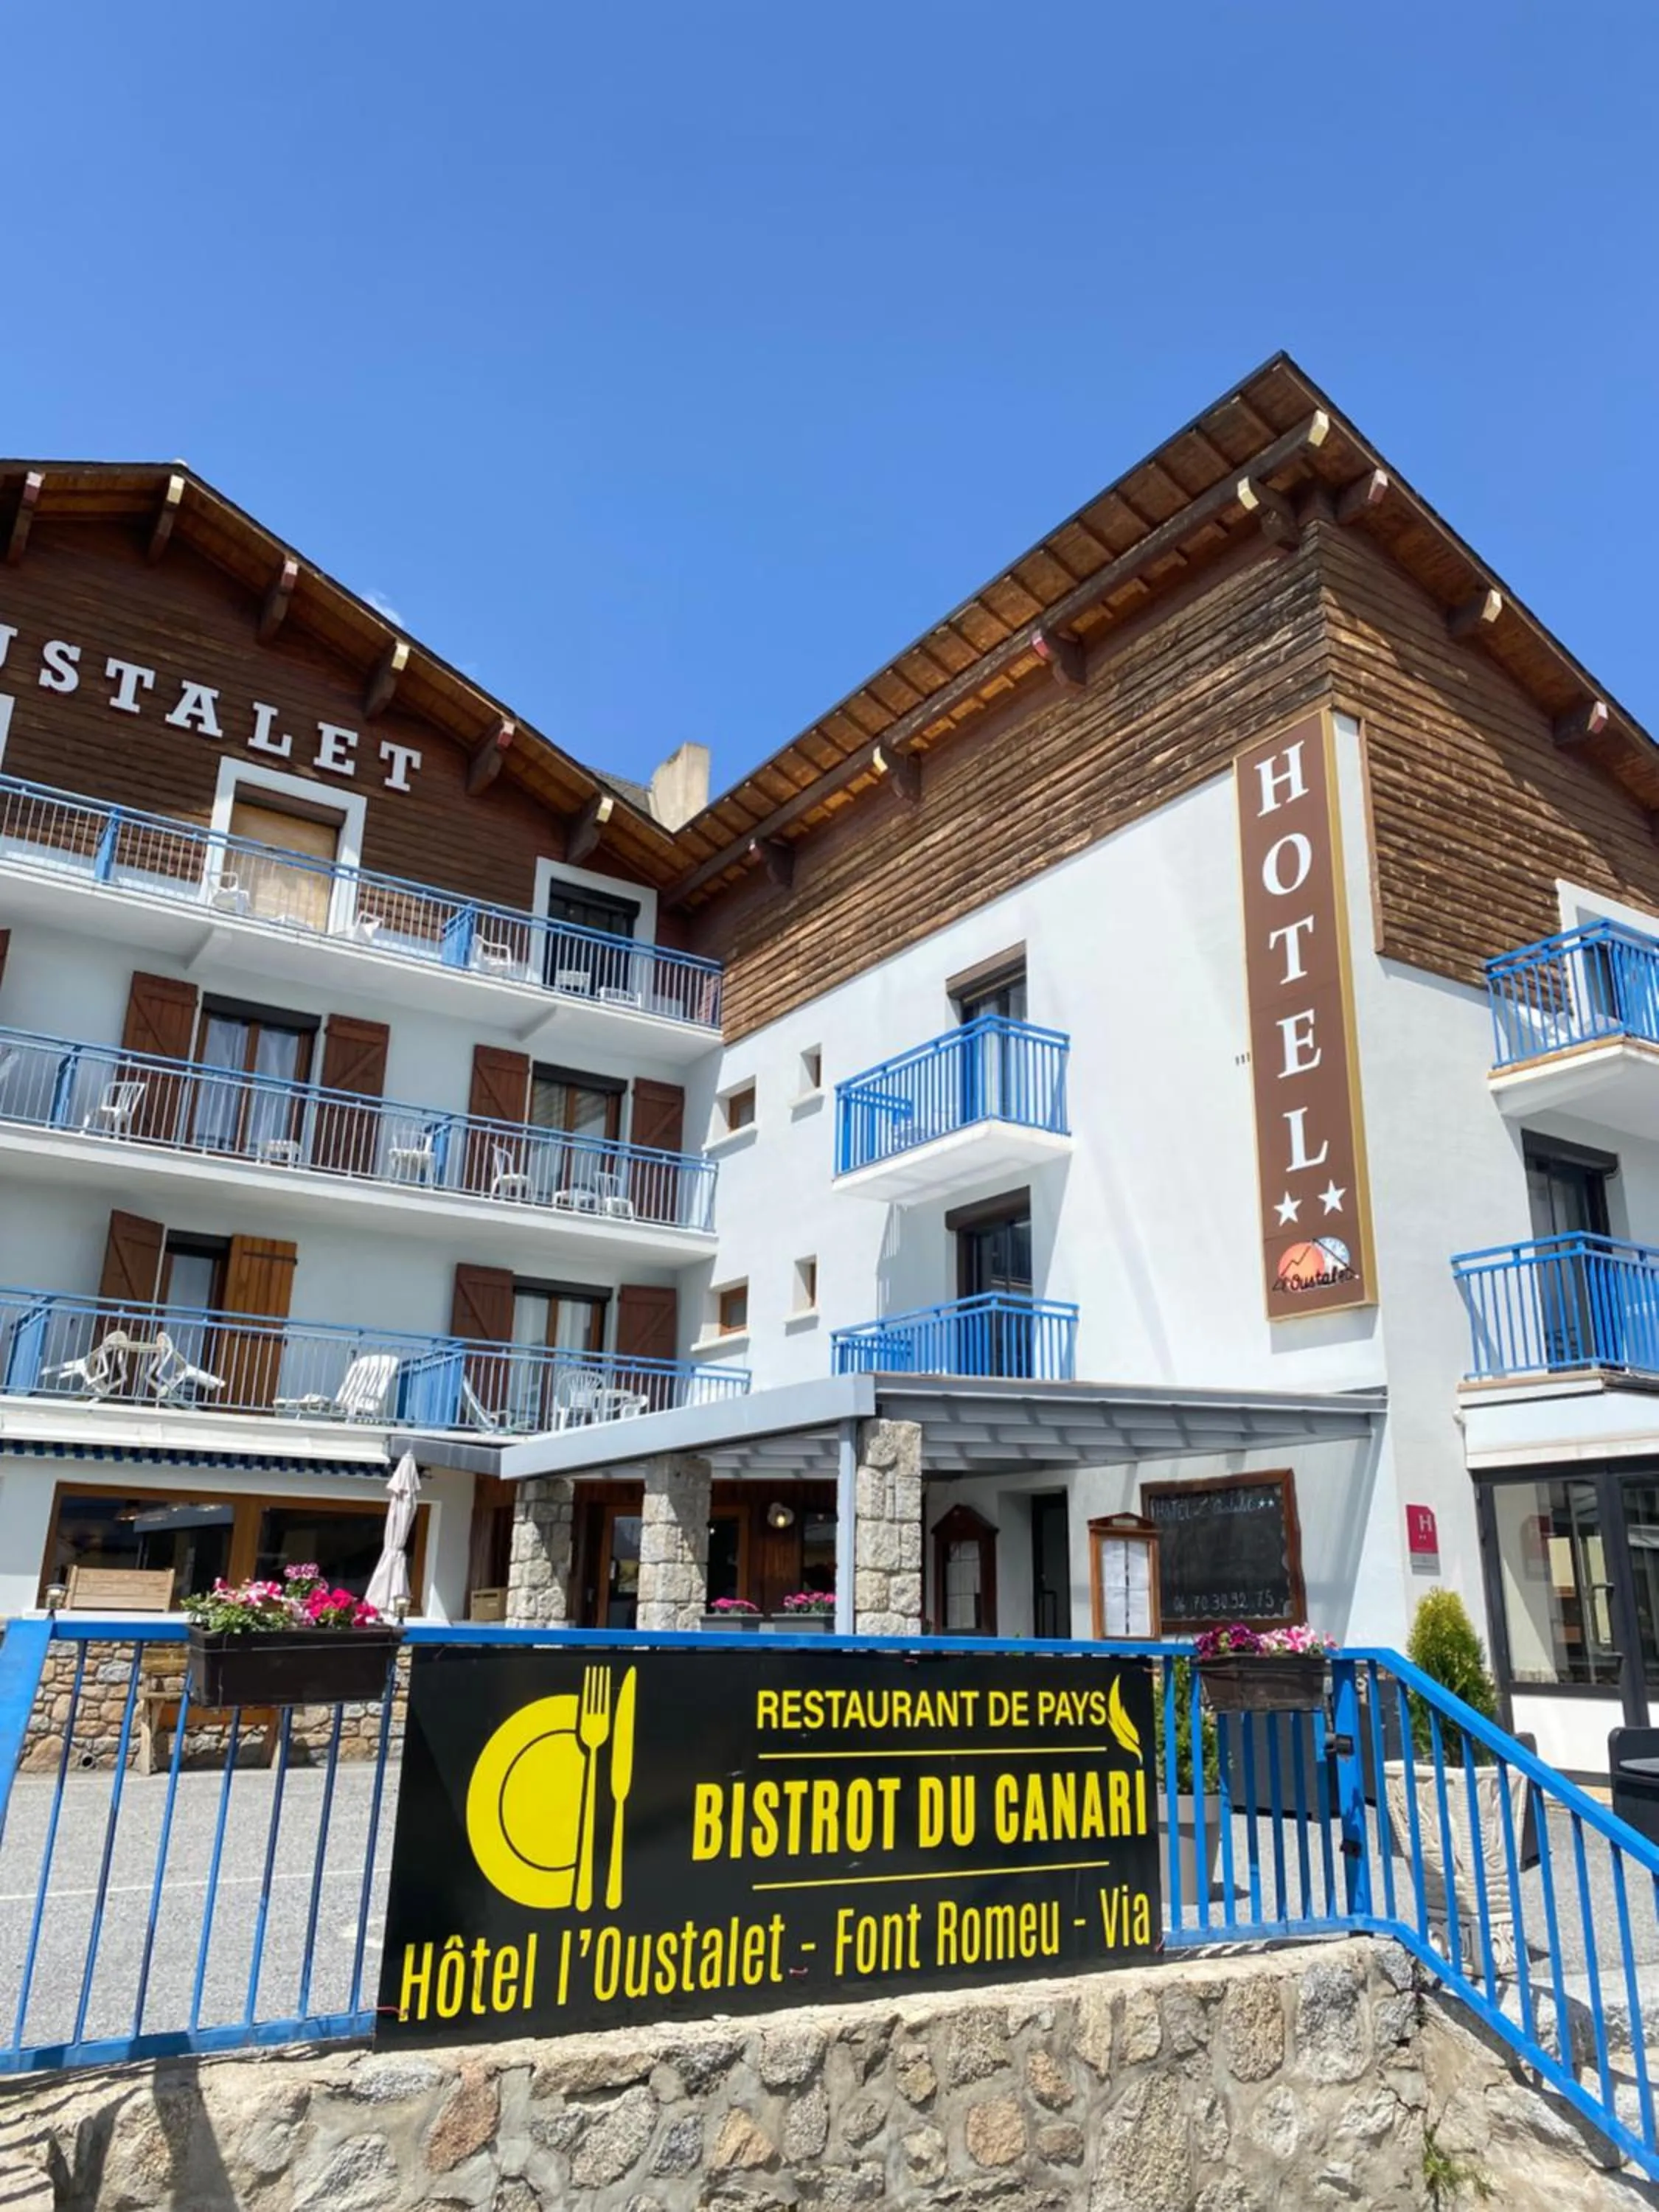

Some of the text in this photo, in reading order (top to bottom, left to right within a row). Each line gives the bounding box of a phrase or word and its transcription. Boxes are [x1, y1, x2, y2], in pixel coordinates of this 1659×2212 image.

[1253, 740, 1329, 1174] HOTEL
[1418, 1513, 1433, 1533] H
[757, 1690, 1107, 1729] RESTAURANT DE PAYS
[692, 1770, 1147, 1861] BISTROT DU CANARI
[398, 1933, 538, 2022] Hôtel
[557, 1913, 785, 2006] l'Oustalet
[835, 1904, 922, 1976] Font
[936, 1900, 1060, 1966] Romeu
[1100, 1885, 1151, 1949] Via
